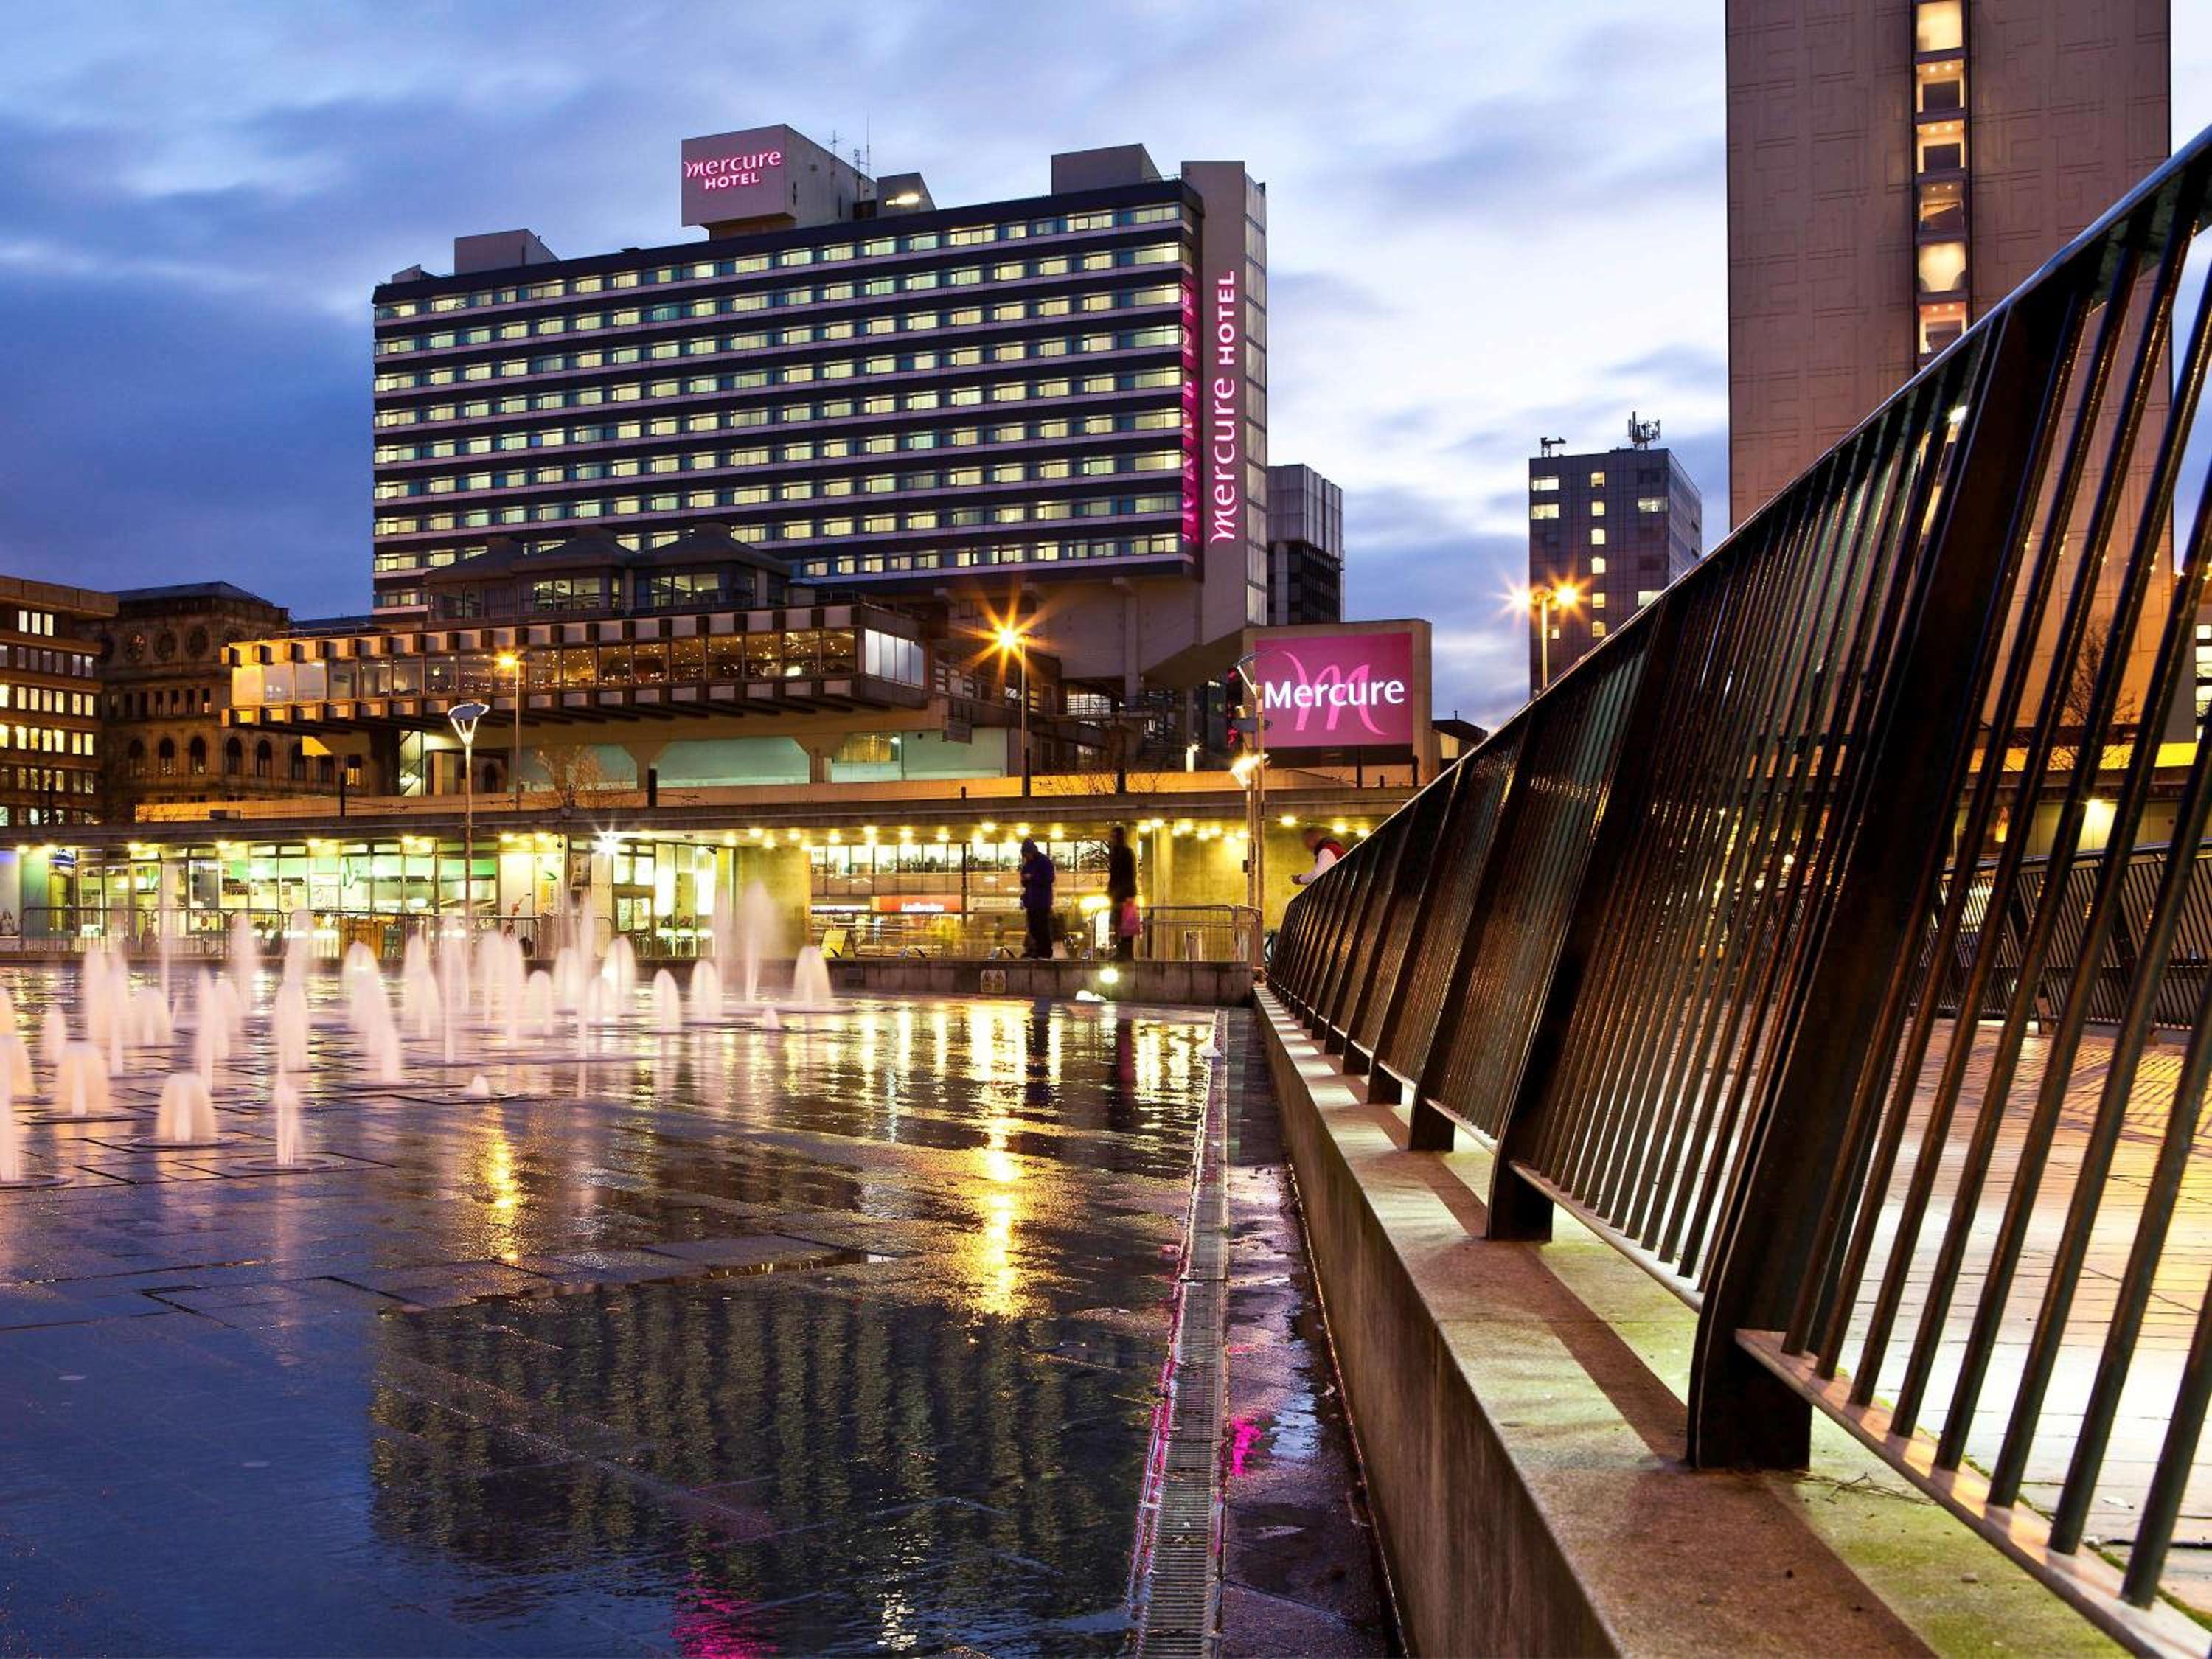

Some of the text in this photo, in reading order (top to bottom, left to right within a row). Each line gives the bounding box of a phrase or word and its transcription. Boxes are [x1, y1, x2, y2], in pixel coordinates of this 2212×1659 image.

[706, 172, 760, 189] HOTEL
[1218, 271, 1235, 365] HOTEL
[1265, 679, 1405, 709] Mercure
